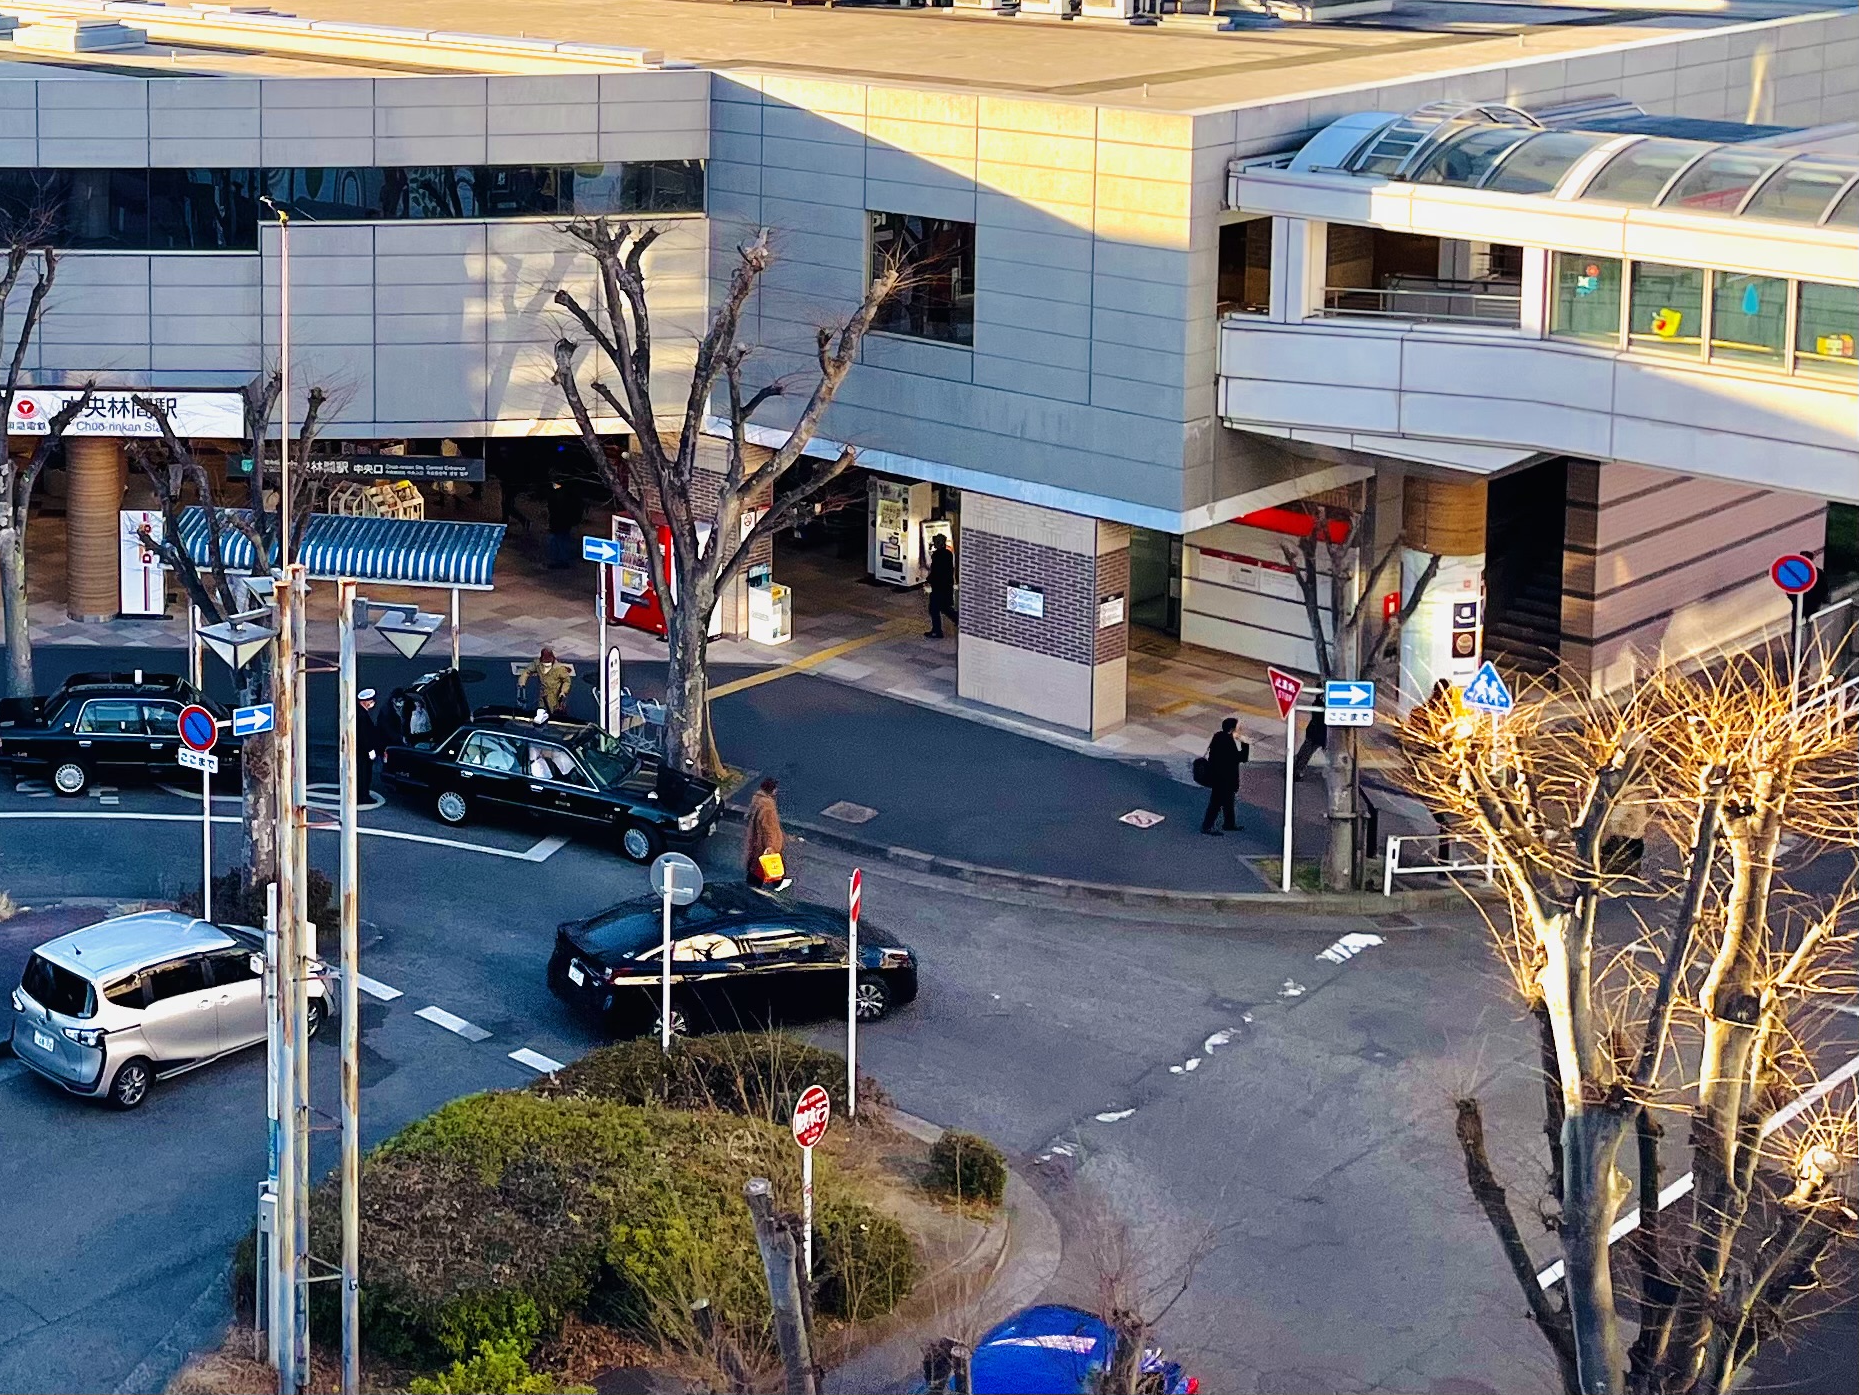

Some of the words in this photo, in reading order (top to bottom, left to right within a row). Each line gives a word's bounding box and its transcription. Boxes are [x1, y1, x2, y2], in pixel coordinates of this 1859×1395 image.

[353, 464, 384, 475] 中央口
[1274, 678, 1296, 694] 止まれ
[1328, 712, 1370, 722] ここまで
[180, 752, 215, 770] ここまで
